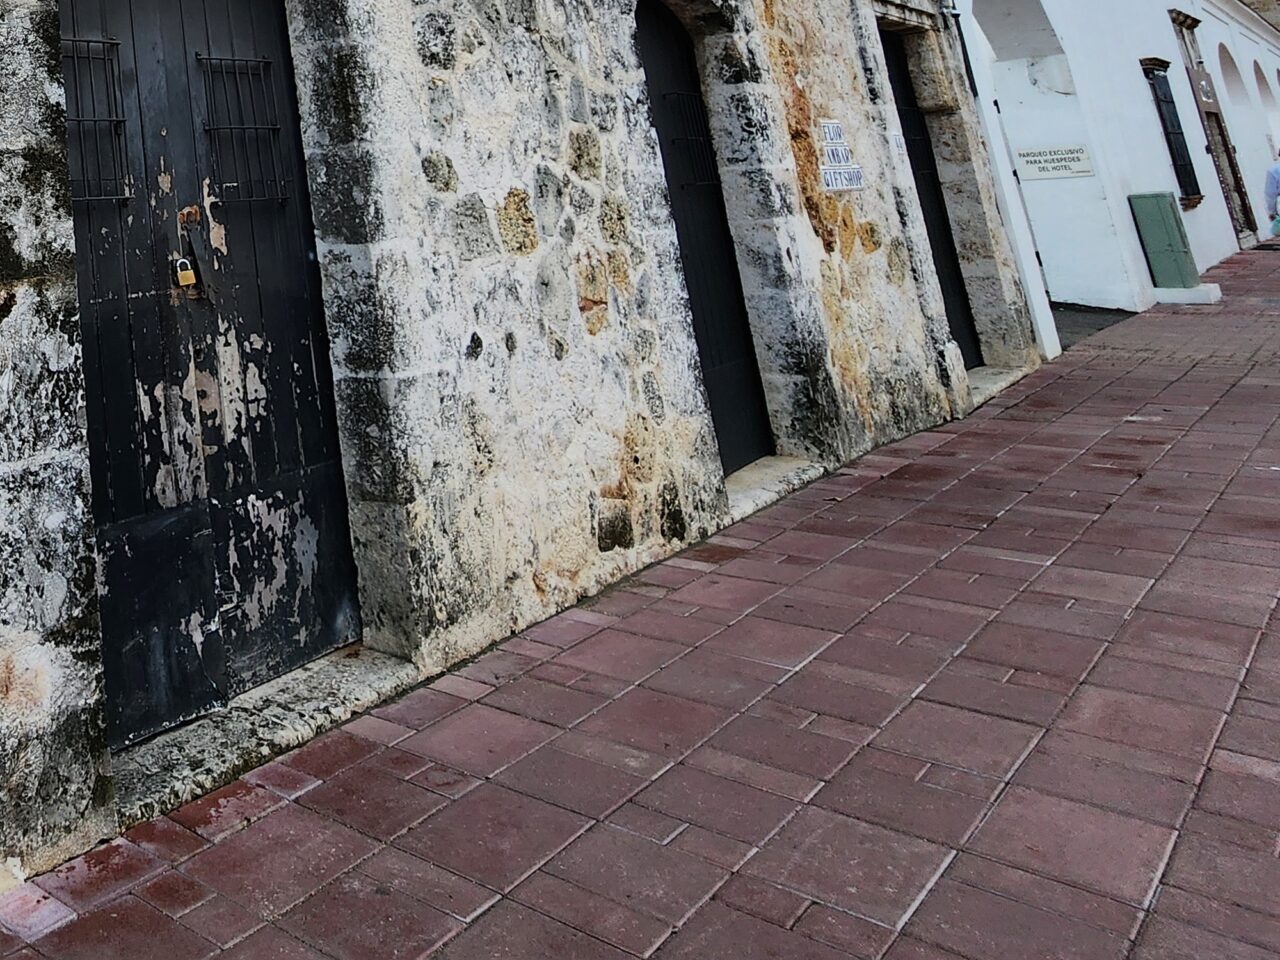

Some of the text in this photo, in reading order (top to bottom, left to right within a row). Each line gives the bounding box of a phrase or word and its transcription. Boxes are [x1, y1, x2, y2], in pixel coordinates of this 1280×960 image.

[822, 124, 843, 141] FLOR
[1018, 148, 1084, 158] PARQUEO EXCLUSIVO
[1043, 156, 1081, 164] HUESPEDES
